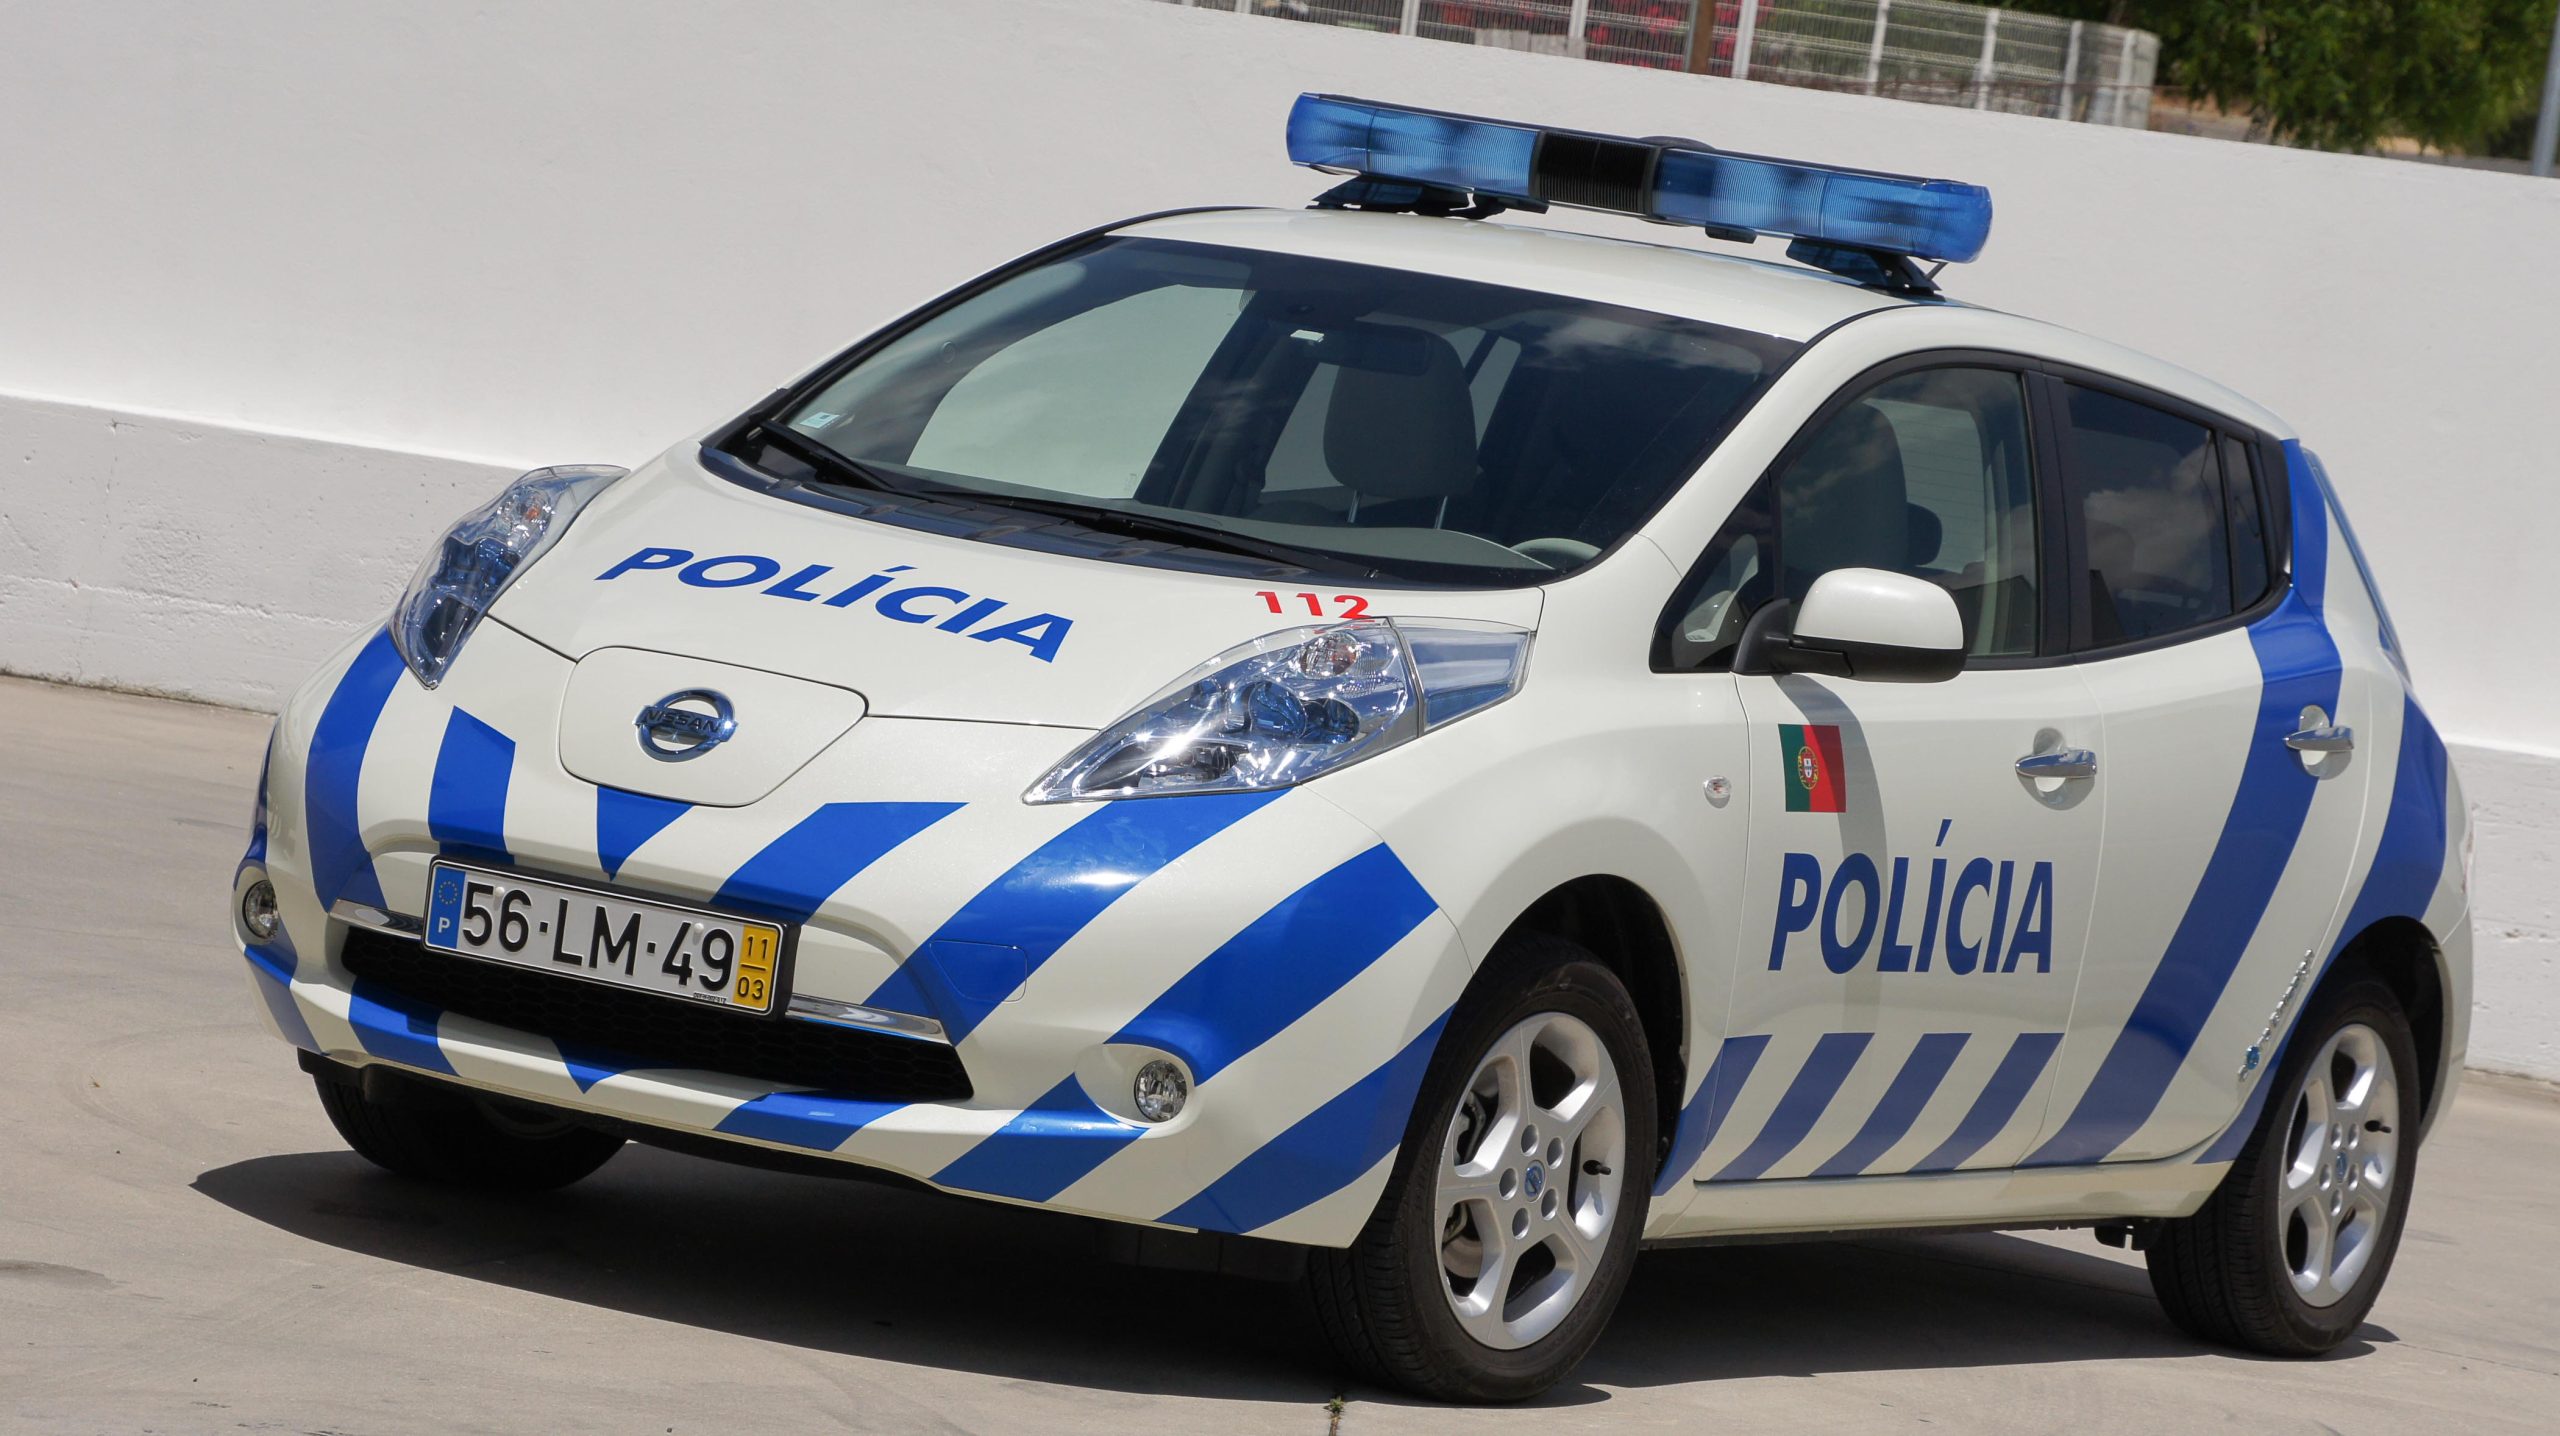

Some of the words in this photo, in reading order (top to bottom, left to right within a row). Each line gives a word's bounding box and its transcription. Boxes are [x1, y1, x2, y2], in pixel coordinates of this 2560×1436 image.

[594, 547, 1074, 663] POLÍCIA
[1255, 591, 1375, 622] 112
[644, 708, 720, 733] NISSAN
[1768, 819, 2053, 975] POLÍCIA
[438, 917, 451, 933] P
[747, 935, 769, 960] 11
[738, 976, 763, 1000] 03
